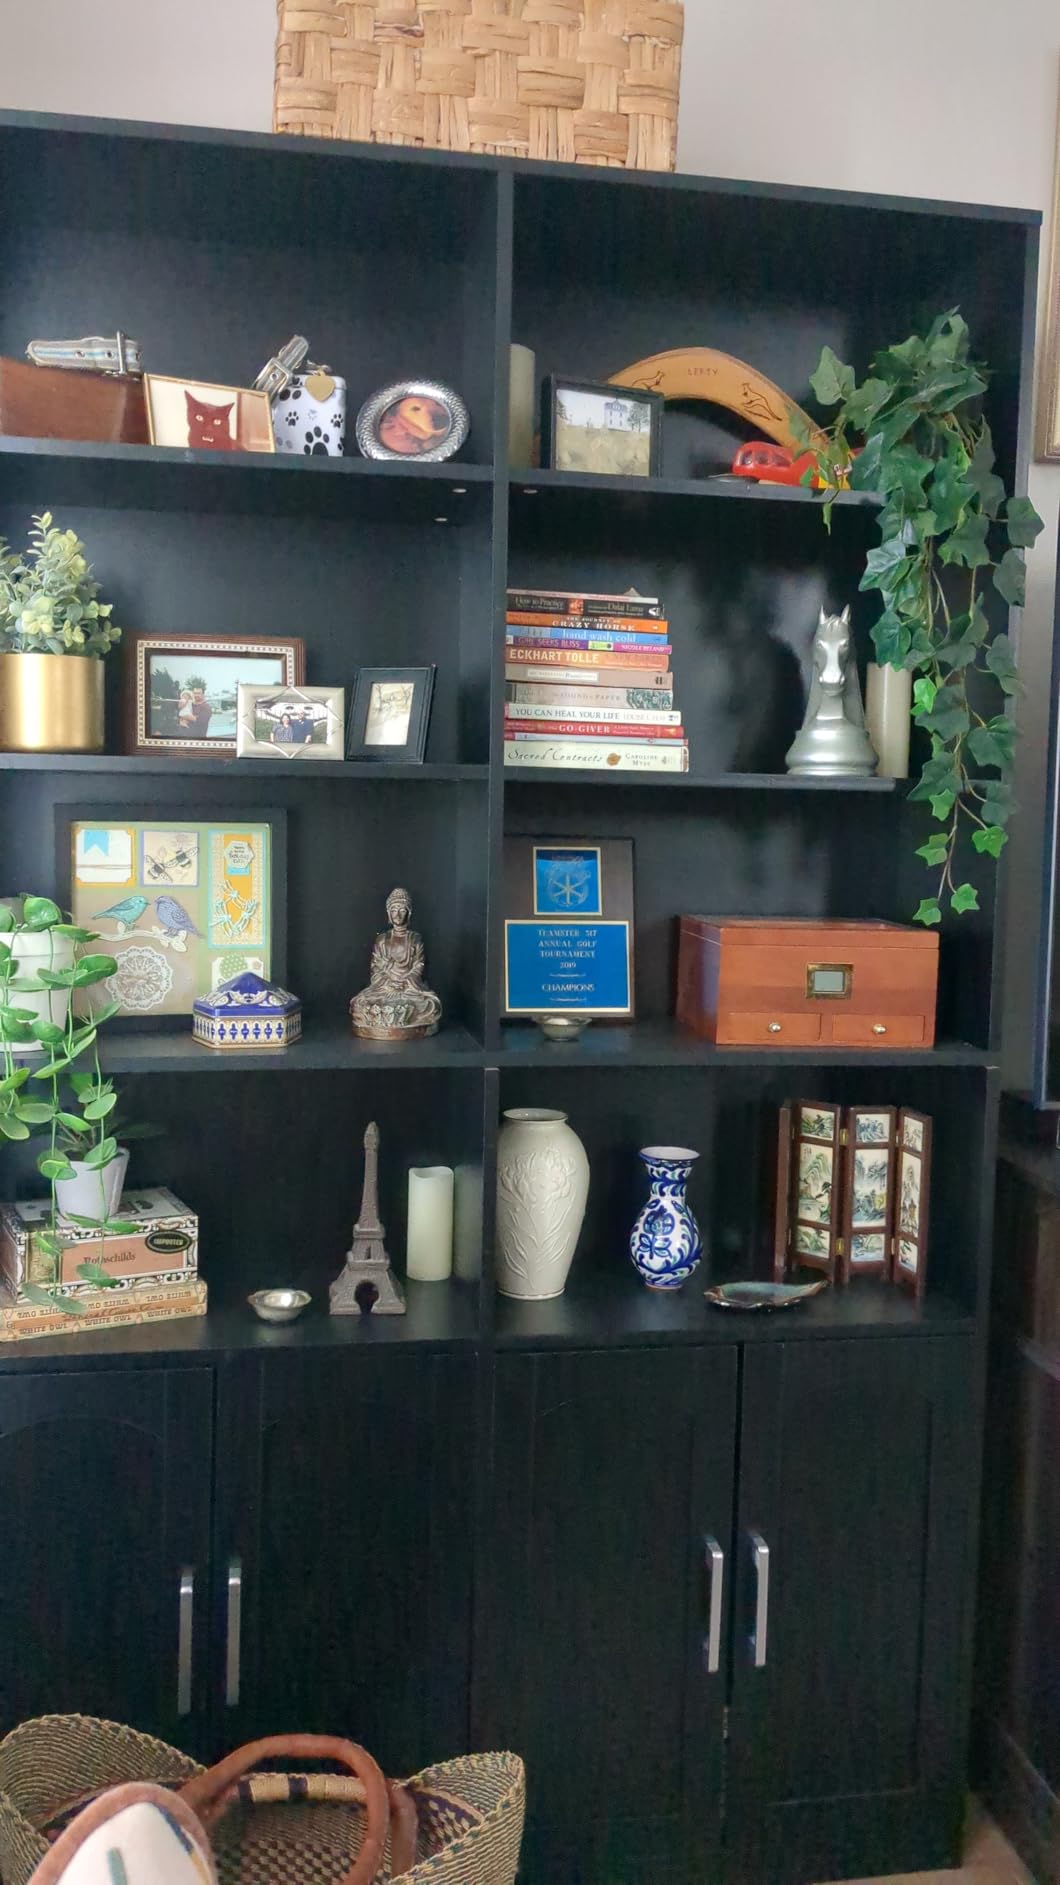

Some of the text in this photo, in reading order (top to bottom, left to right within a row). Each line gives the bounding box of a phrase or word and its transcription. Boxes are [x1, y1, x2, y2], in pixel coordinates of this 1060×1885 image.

[552, 620, 636, 631] CRAZY HORSE
[563, 629, 636, 643] hand wash cold
[510, 648, 562, 661] ECKHART
[564, 651, 600, 664] TOLLE
[515, 707, 620, 720] YOU CAN HEAL YOUR LIFE
[507, 748, 553, 761] Sacred
[538, 929, 579, 937] TEAMSTER
[538, 940, 597, 948] ANNUAL GOLF
[540, 950, 596, 958] TOURNAMENT
[541, 983, 596, 992] CHAMPIONS
[83, 1251, 137, 1265] Rothschilds
[84, 1314, 131, 1326] WHITE OWL
[49, 1322, 68, 1332] OWL
